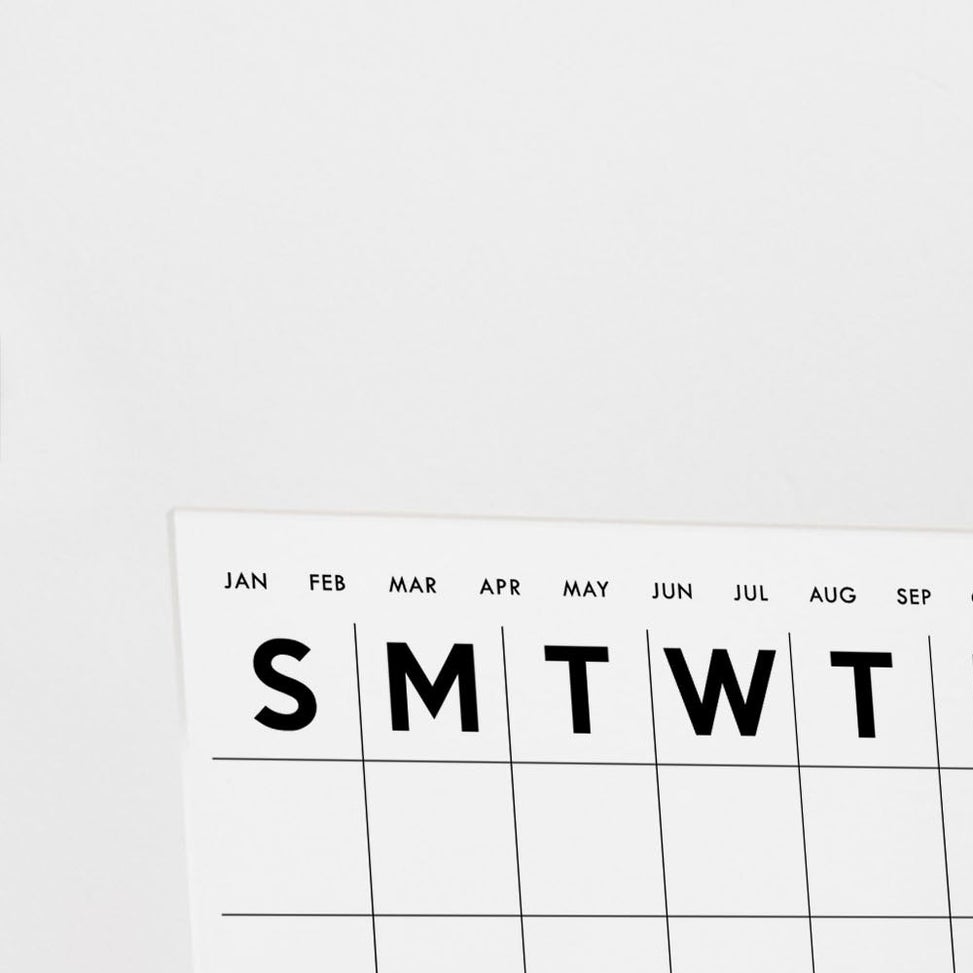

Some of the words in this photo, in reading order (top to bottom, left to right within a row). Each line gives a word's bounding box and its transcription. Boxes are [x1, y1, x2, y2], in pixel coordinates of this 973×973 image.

[224, 571, 268, 590] JAN
[309, 573, 346, 592] FEB
[388, 576, 437, 594] MAR
[479, 578, 521, 596] APR
[562, 579, 609, 598] MAY
[651, 582, 693, 600] JUN
[733, 584, 769, 602] JUL
[809, 586, 857, 604] AUG
[896, 587, 932, 606] SEP
[253, 638, 317, 731] S
[387, 642, 479, 732] M
[544, 645, 609, 734] T
[663, 648, 776, 736] W
[830, 651, 893, 738] T
